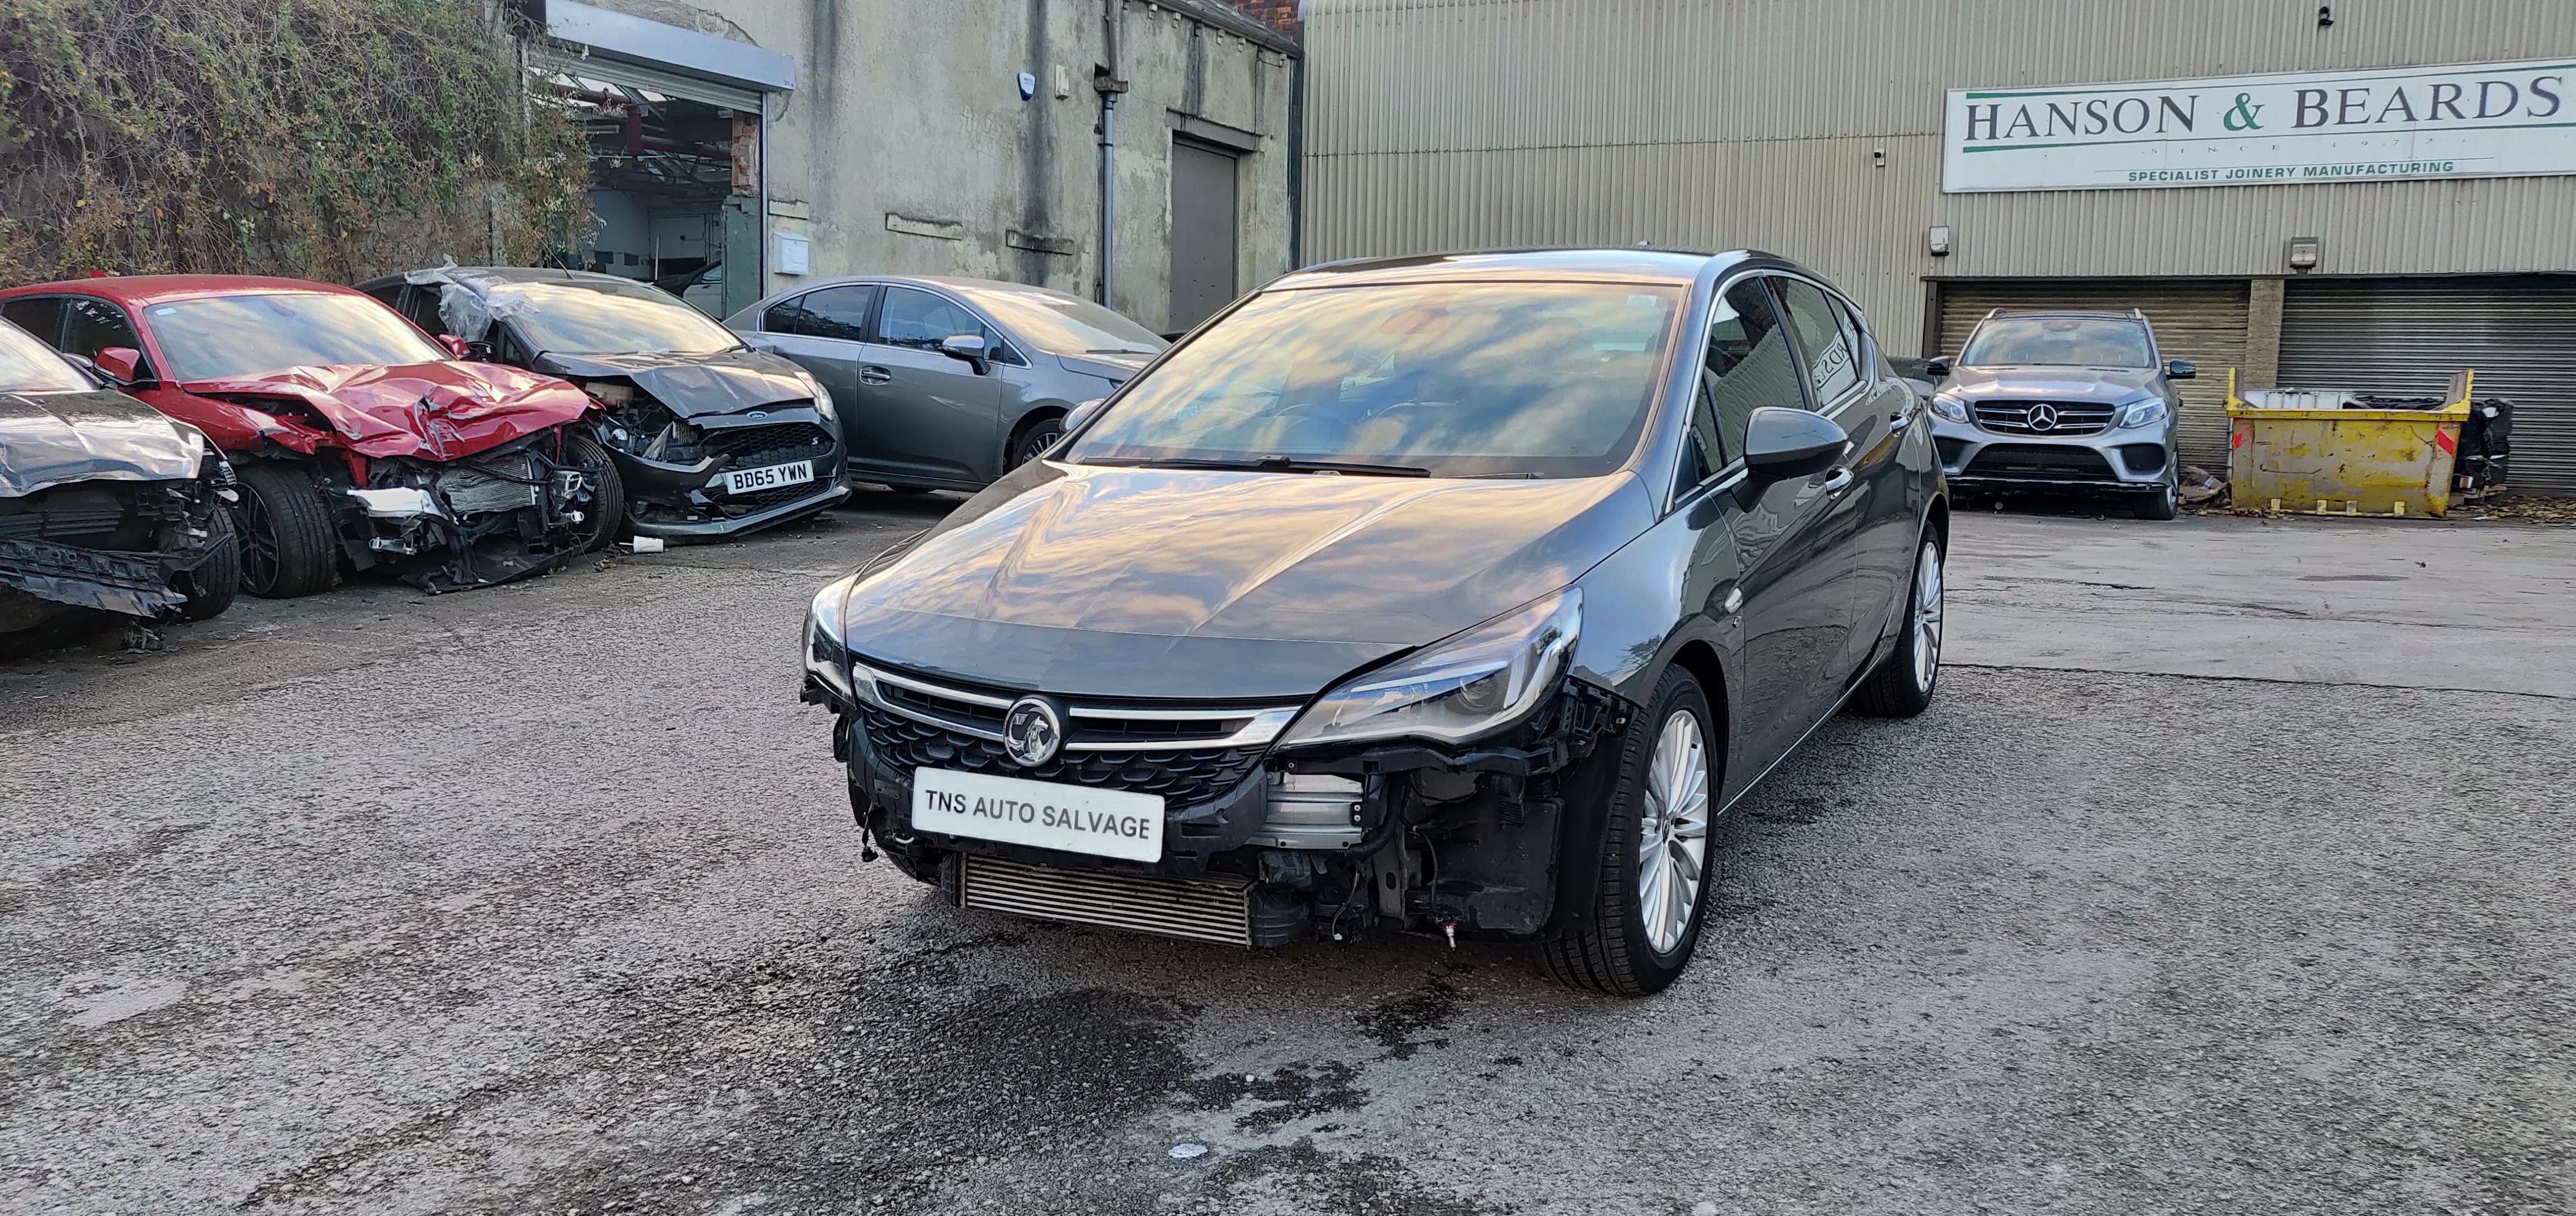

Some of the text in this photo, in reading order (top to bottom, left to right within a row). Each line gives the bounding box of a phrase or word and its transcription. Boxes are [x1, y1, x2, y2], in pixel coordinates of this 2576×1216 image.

[1964, 77, 2561, 140] HANSON & BEARDS
[2128, 162, 2454, 182] SPECIALIST JOINERY MANUFACTURING
[733, 464, 807, 490] BD65 YWN
[925, 789, 1150, 840] TNS AUTO SALVAGE
